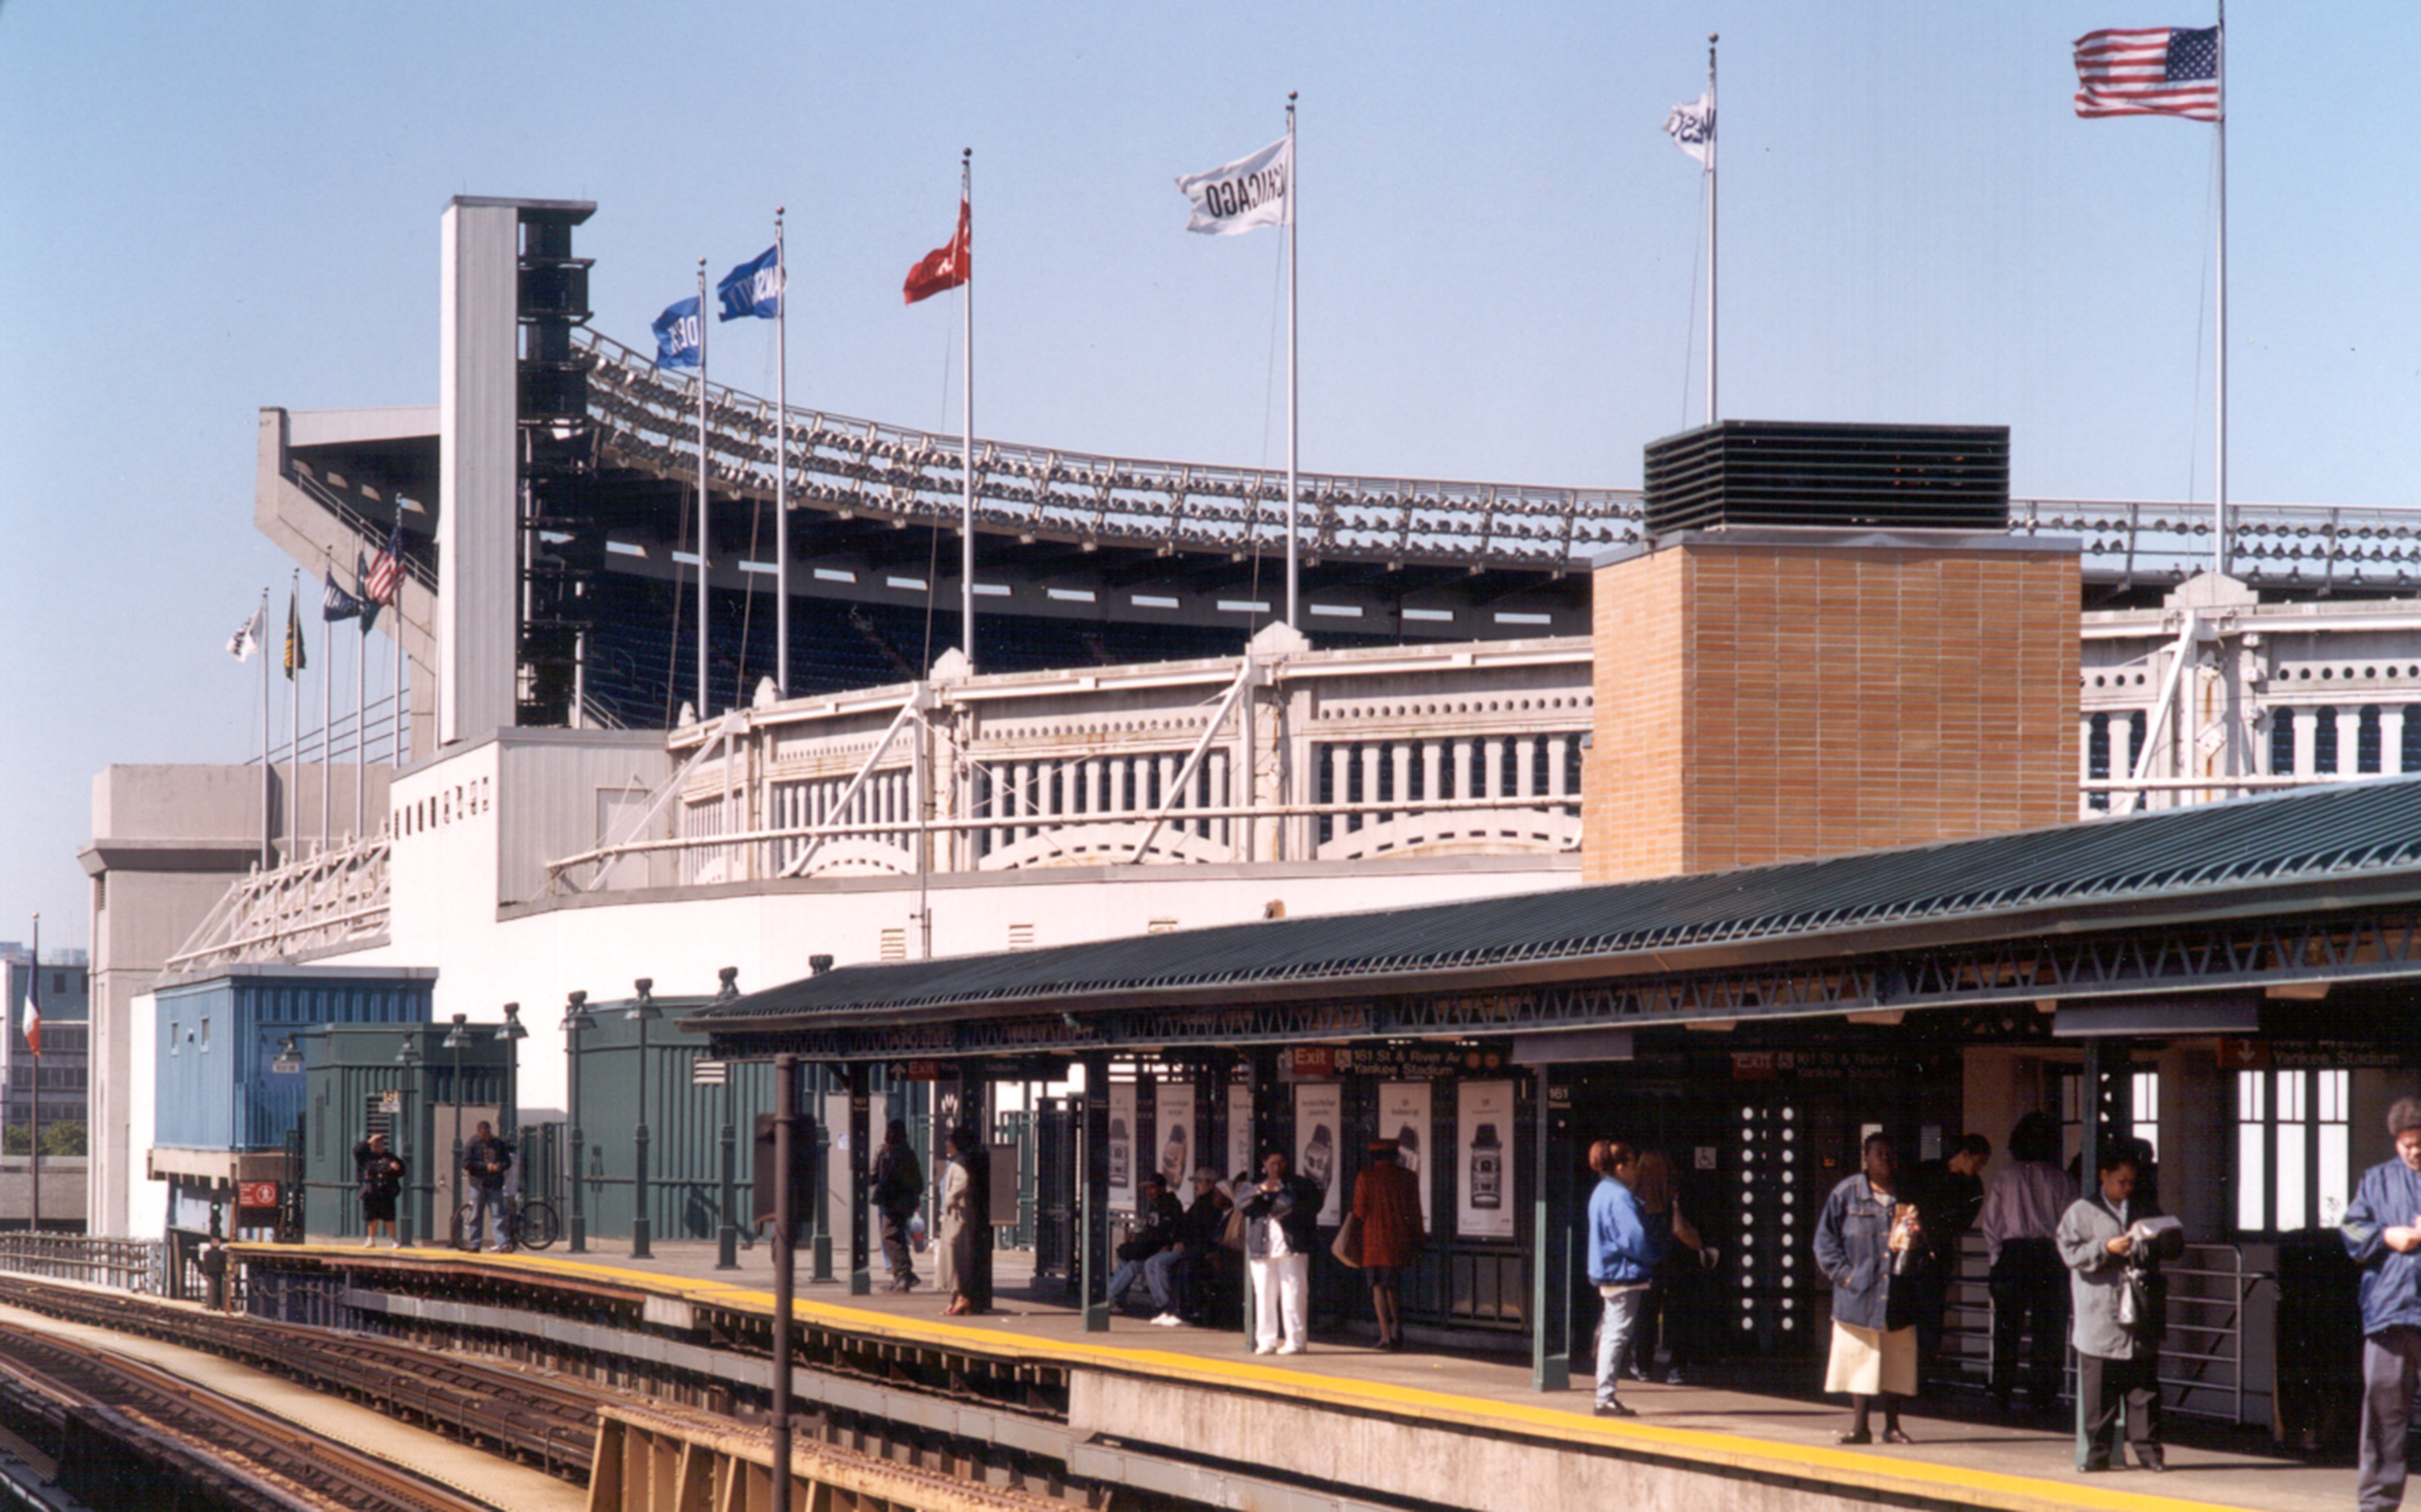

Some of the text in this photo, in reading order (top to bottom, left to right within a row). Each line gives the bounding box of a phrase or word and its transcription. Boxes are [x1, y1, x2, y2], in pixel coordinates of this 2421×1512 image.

[1294, 1048, 1327, 1065] Exit
[1353, 1050, 1372, 1063] 161
[1377, 1050, 1391, 1063] St
[1410, 1050, 1441, 1063] River
[1445, 1051, 1461, 1063] Av
[2273, 1050, 2400, 1066] Yankee Stadium
[908, 1061, 935, 1075] Exit
[1353, 1063, 1453, 1076] Yankee Stadium
[1549, 1088, 1569, 1100] 161
